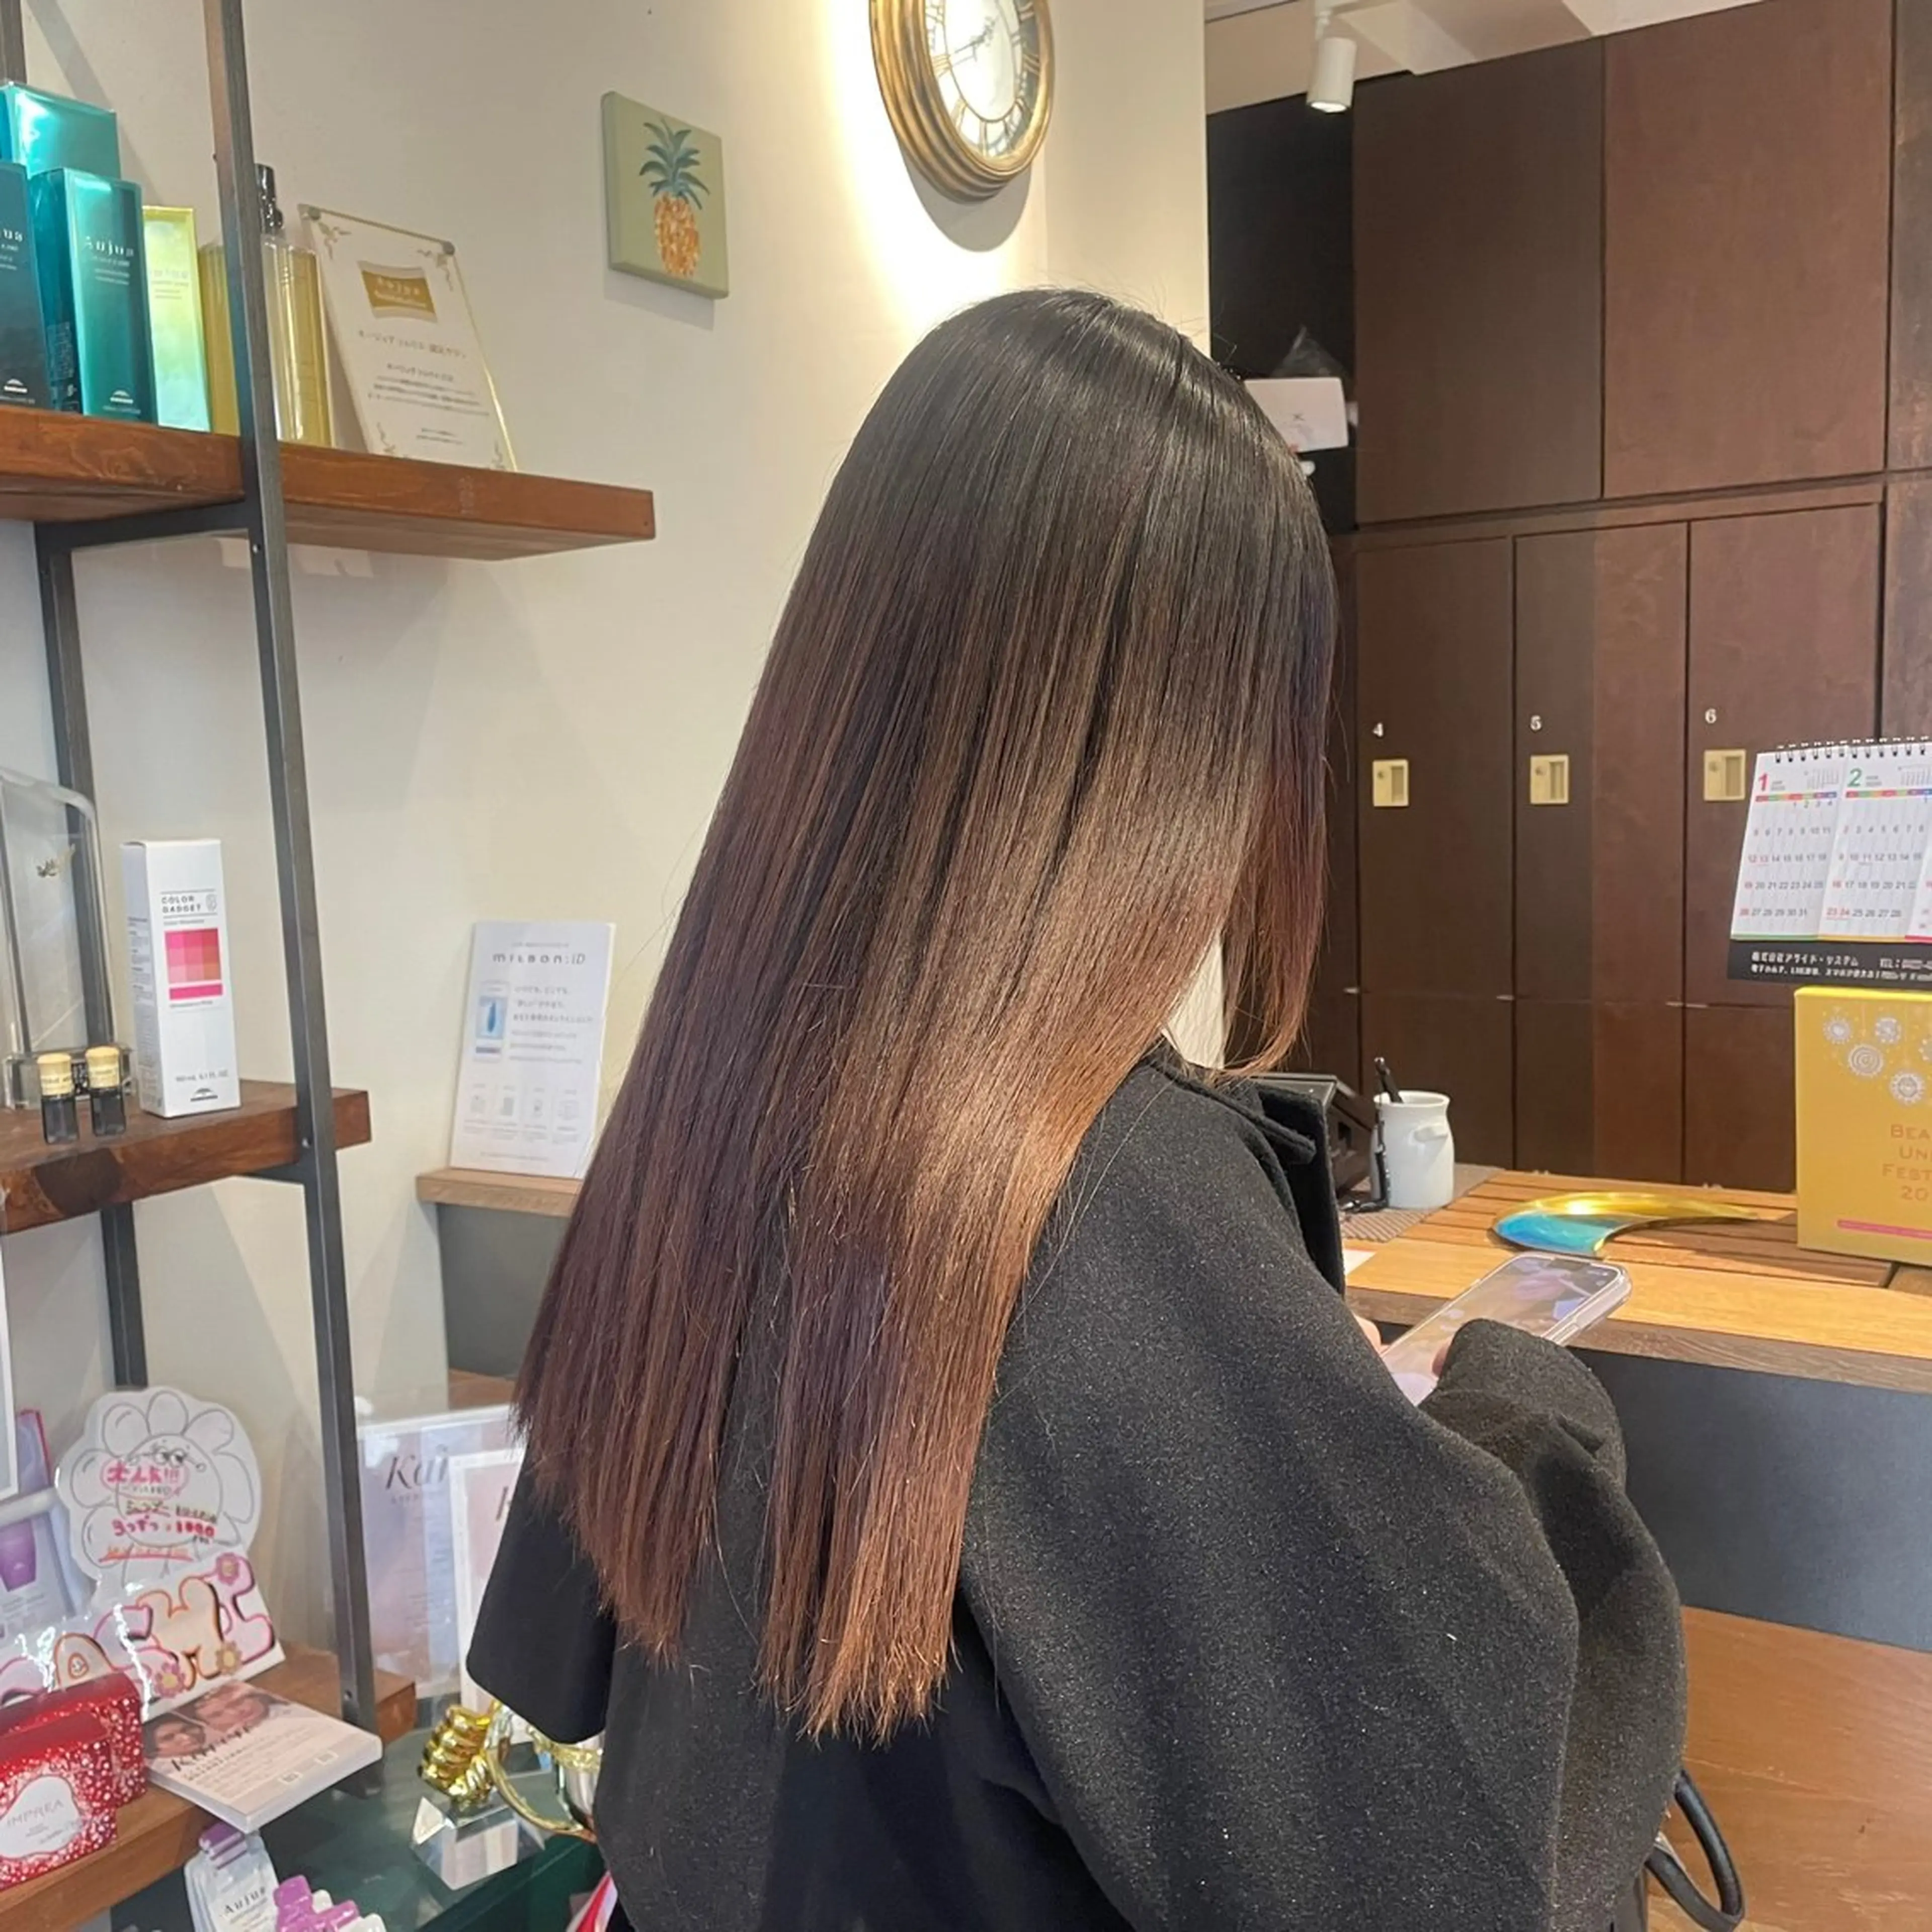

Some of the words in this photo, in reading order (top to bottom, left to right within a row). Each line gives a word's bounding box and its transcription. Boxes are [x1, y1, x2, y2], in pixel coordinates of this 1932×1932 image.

[1531, 715, 1542, 731] 5
[1705, 708, 1717, 723] 6
[1373, 722, 1384, 738] 4
[1758, 772, 1768, 791] 1
[1847, 767, 1863, 787] 2
[162, 896, 195, 904] COLOR
[162, 903, 201, 914] GADGET
[1900, 1185, 1929, 1201] 20
